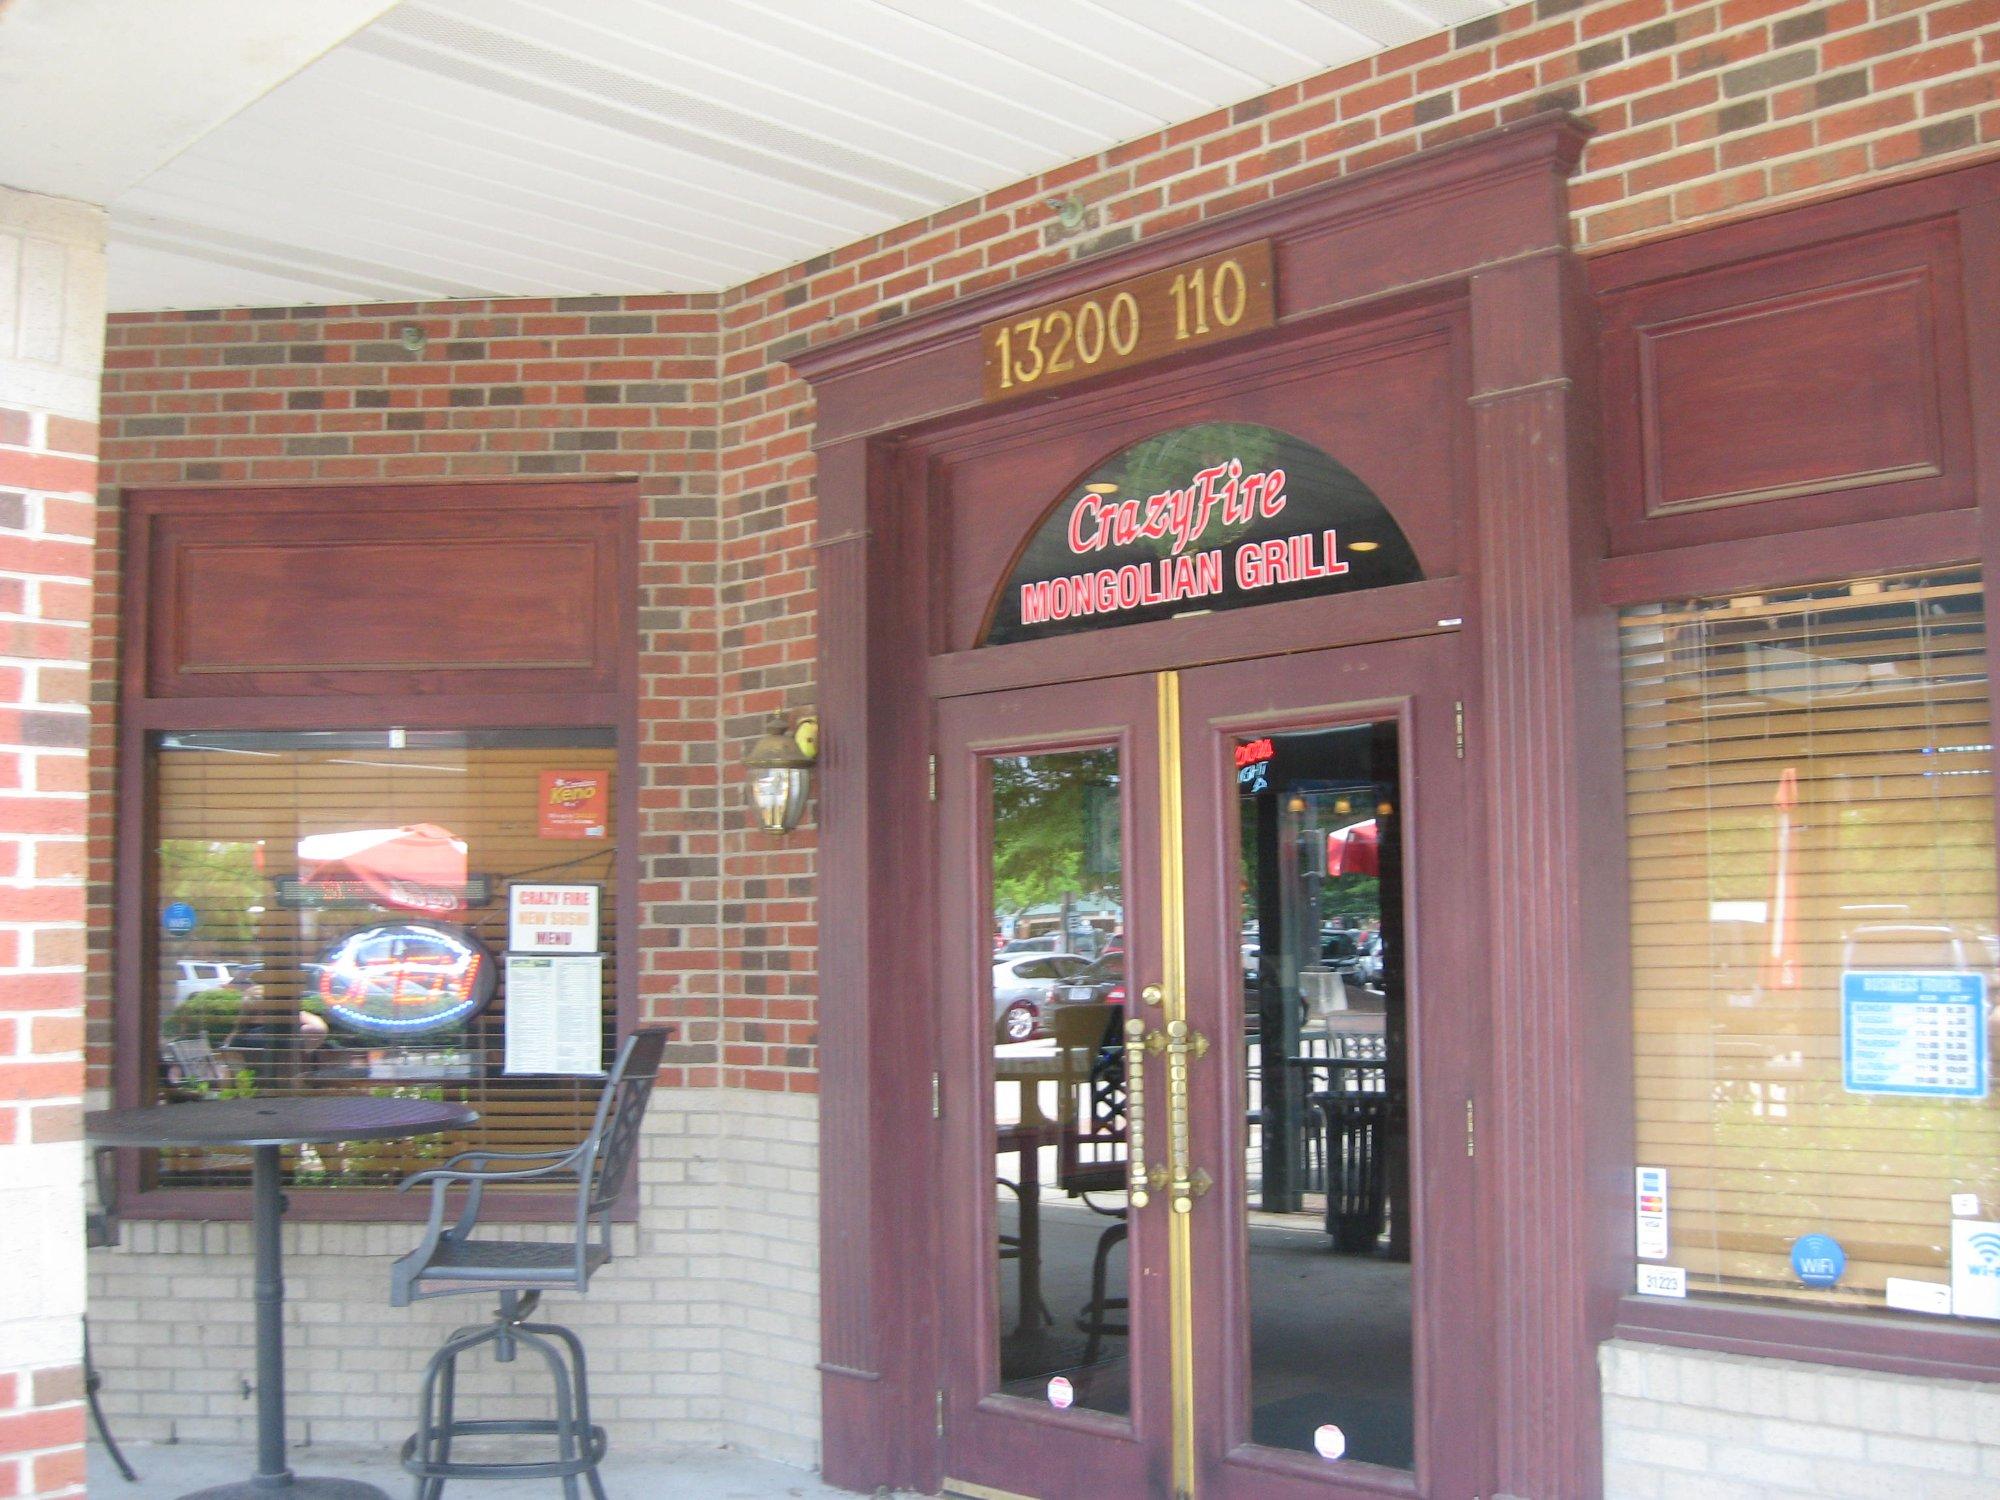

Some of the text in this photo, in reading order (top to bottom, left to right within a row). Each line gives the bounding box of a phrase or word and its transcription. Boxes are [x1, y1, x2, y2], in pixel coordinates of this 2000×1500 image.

[994, 259, 1247, 389] 13200 110
[1020, 529, 1350, 625] MONGOLIAN GRILL
[548, 786, 596, 806] Keno
[519, 890, 591, 906] CRAZY FIRE
[536, 931, 573, 946] MENU
